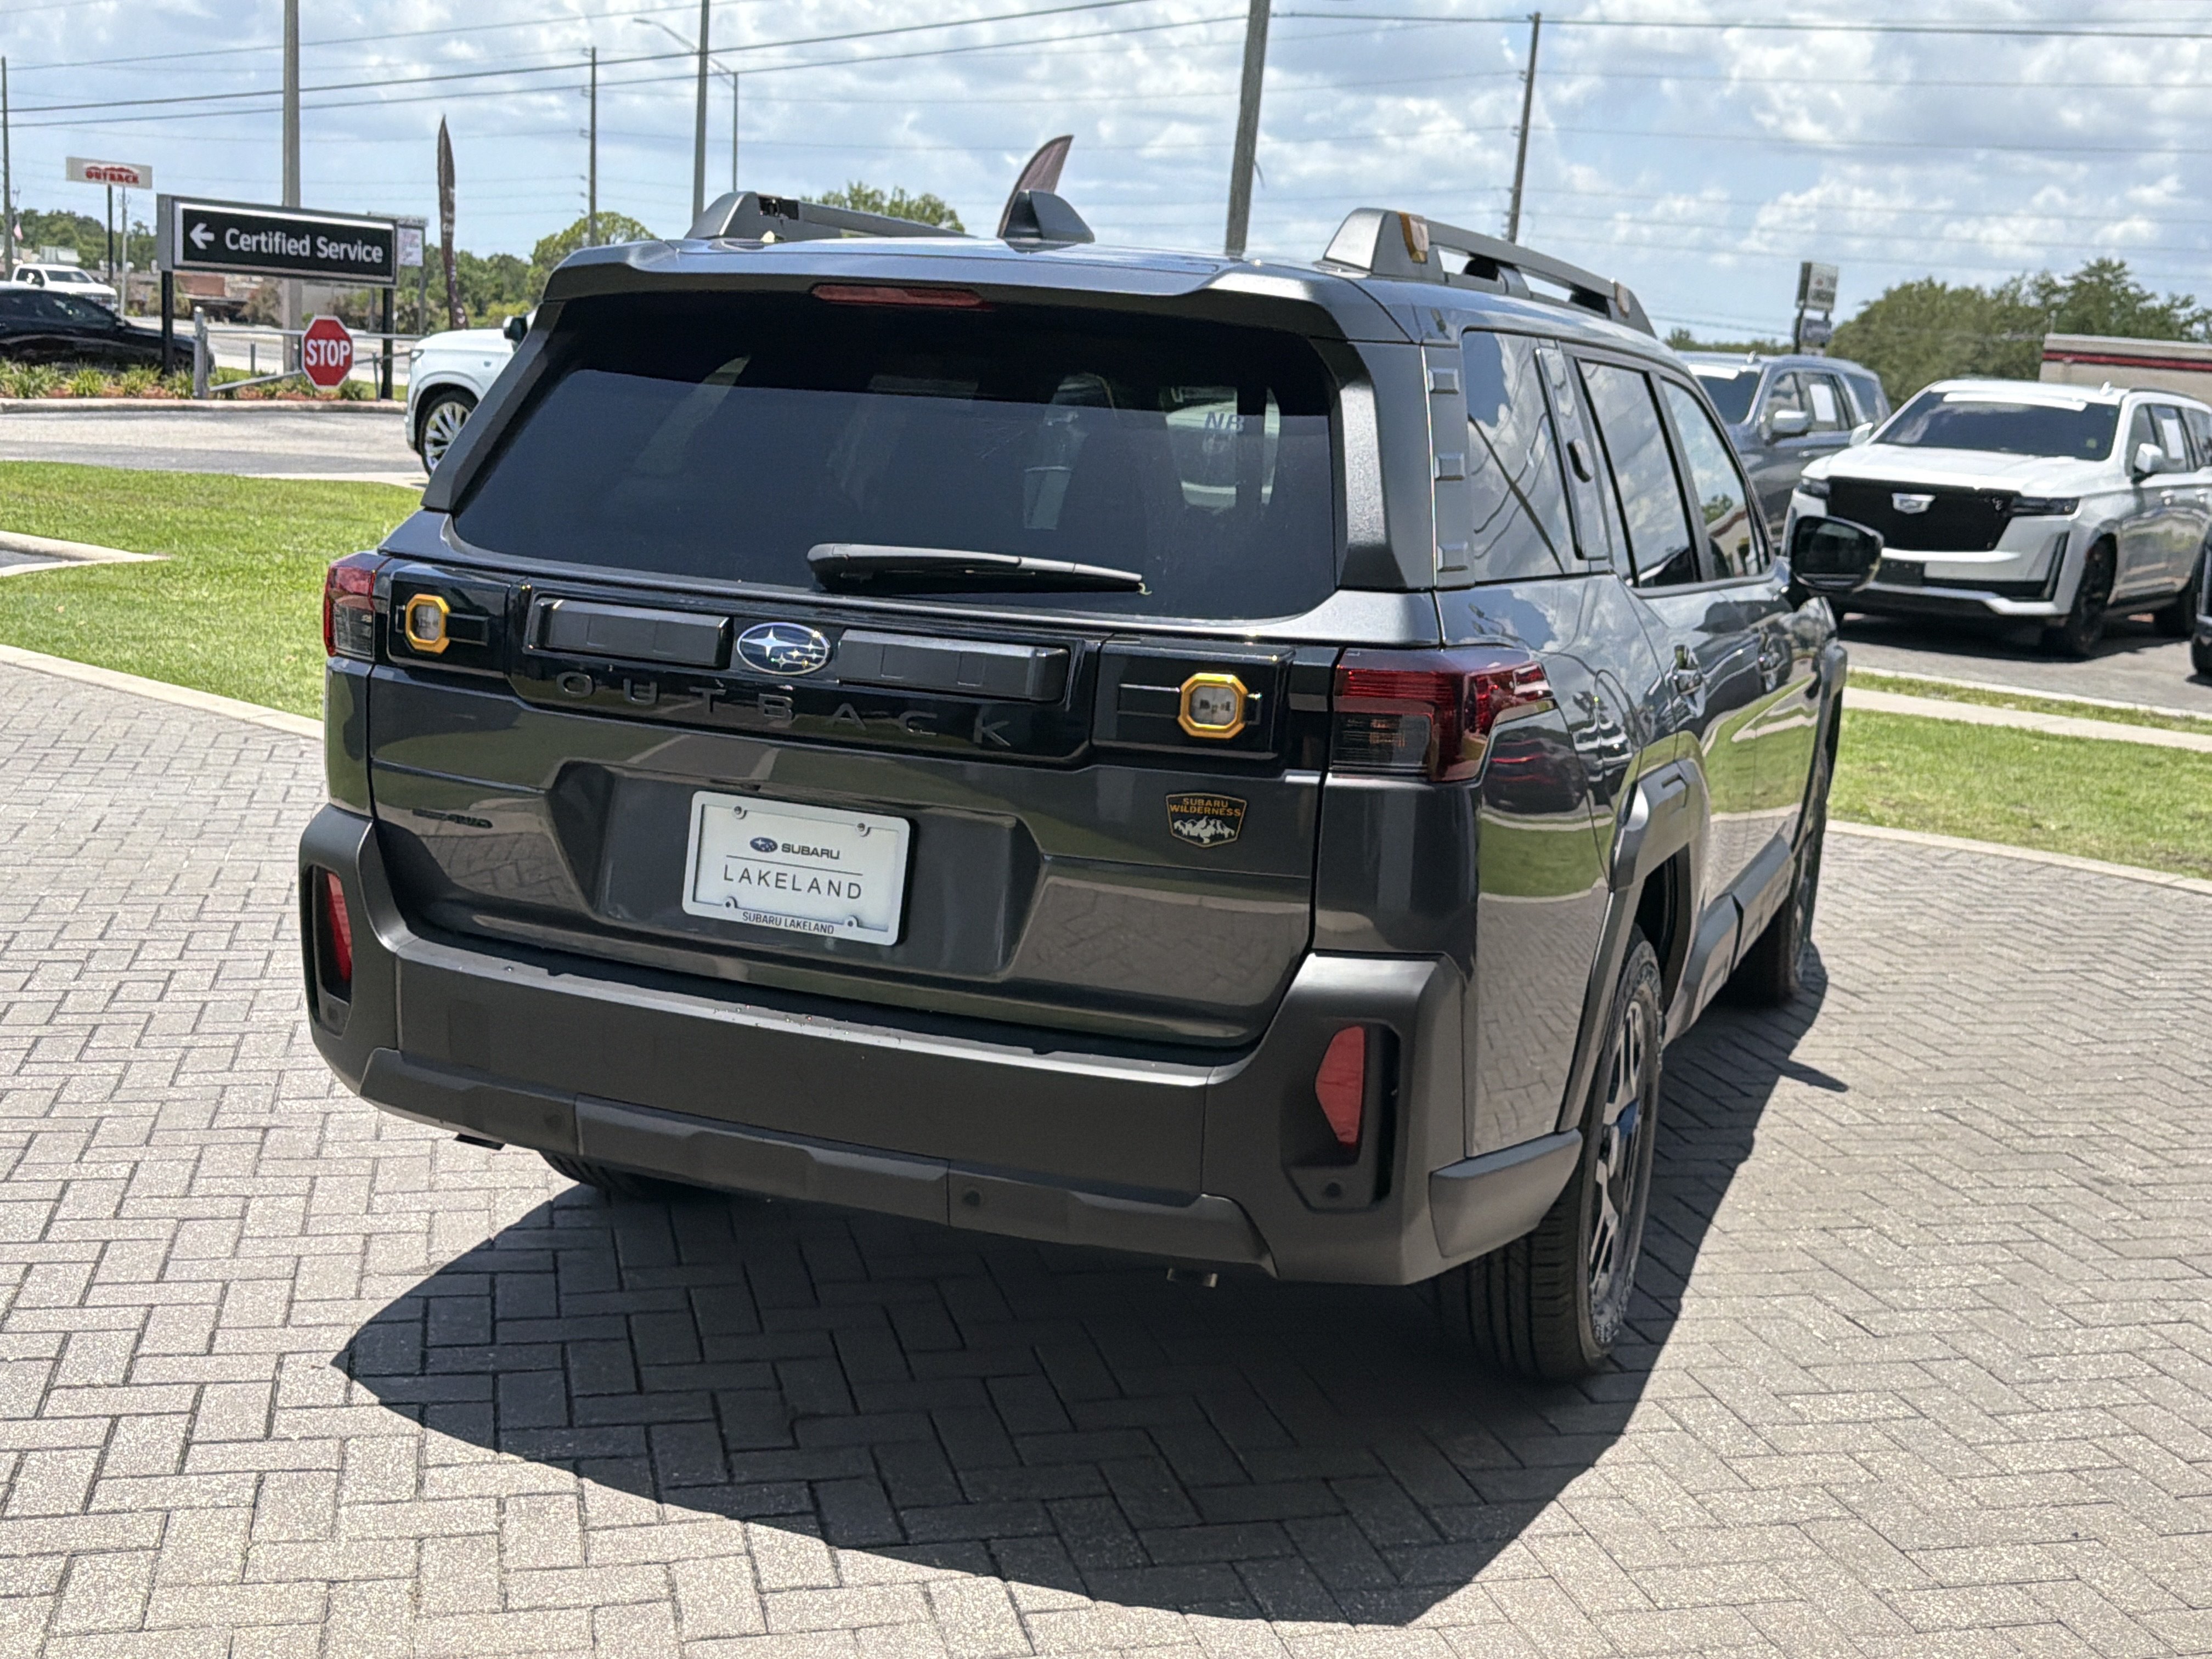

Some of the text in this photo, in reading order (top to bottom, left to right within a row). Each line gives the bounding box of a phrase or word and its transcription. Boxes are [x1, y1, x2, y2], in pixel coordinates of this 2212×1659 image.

[225, 228, 311, 257] Certified
[316, 236, 383, 264] Service
[306, 339, 351, 366] STOP
[556, 670, 1011, 747] OUTBACK
[1170, 804, 1242, 817] WILDERNESS
[1182, 797, 1229, 808] SUBARU
[781, 843, 840, 860] SUBARU
[724, 864, 862, 899] LAKELAND
[742, 911, 834, 935] SUBARU LAKELAND
